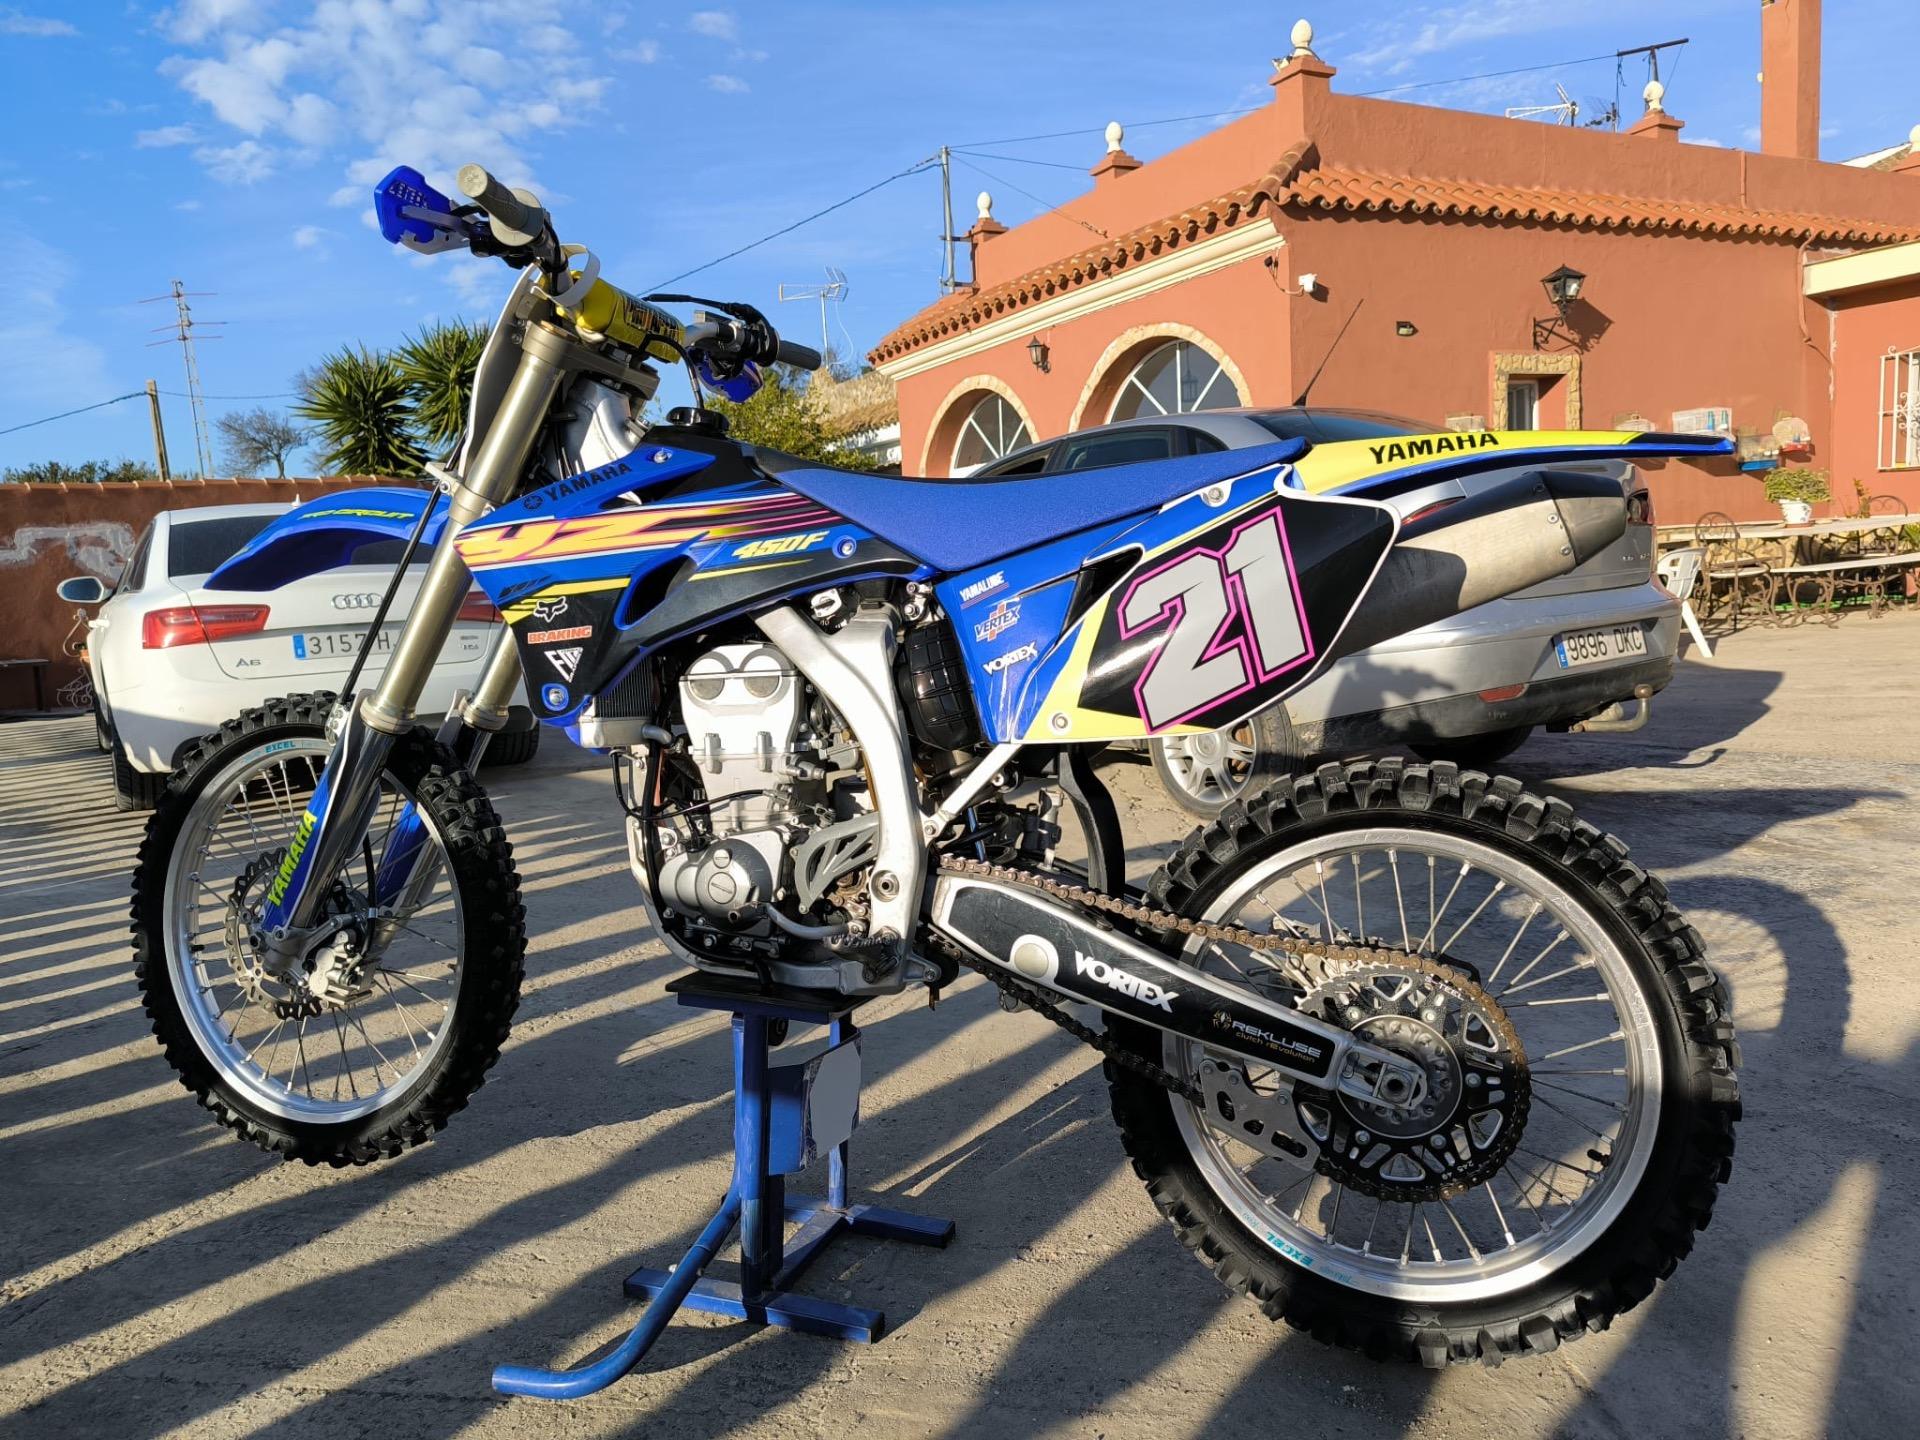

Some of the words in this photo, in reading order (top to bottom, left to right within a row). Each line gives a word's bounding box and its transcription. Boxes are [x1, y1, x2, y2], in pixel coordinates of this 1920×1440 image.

[1369, 433, 1499, 464] YAMAHA
[544, 462, 632, 500] YAMAHA
[731, 530, 831, 559] 450F
[527, 625, 593, 645] BRAKING
[975, 604, 1021, 637] VERTEX
[1117, 505, 1316, 735] 21
[308, 632, 368, 655] 3157
[982, 641, 1038, 675] VORTEX
[1567, 631, 1608, 661] 9896
[1613, 625, 1642, 654] DKC
[236, 658, 261, 668] A6
[264, 740, 297, 754] EXCEL
[267, 810, 318, 906] YAMAHA
[1075, 951, 1180, 1014] VORTEX
[1231, 1020, 1322, 1059] REKLUSE
[1235, 1031, 1264, 1046] clutch
[1265, 1231, 1315, 1267] EXCEL
